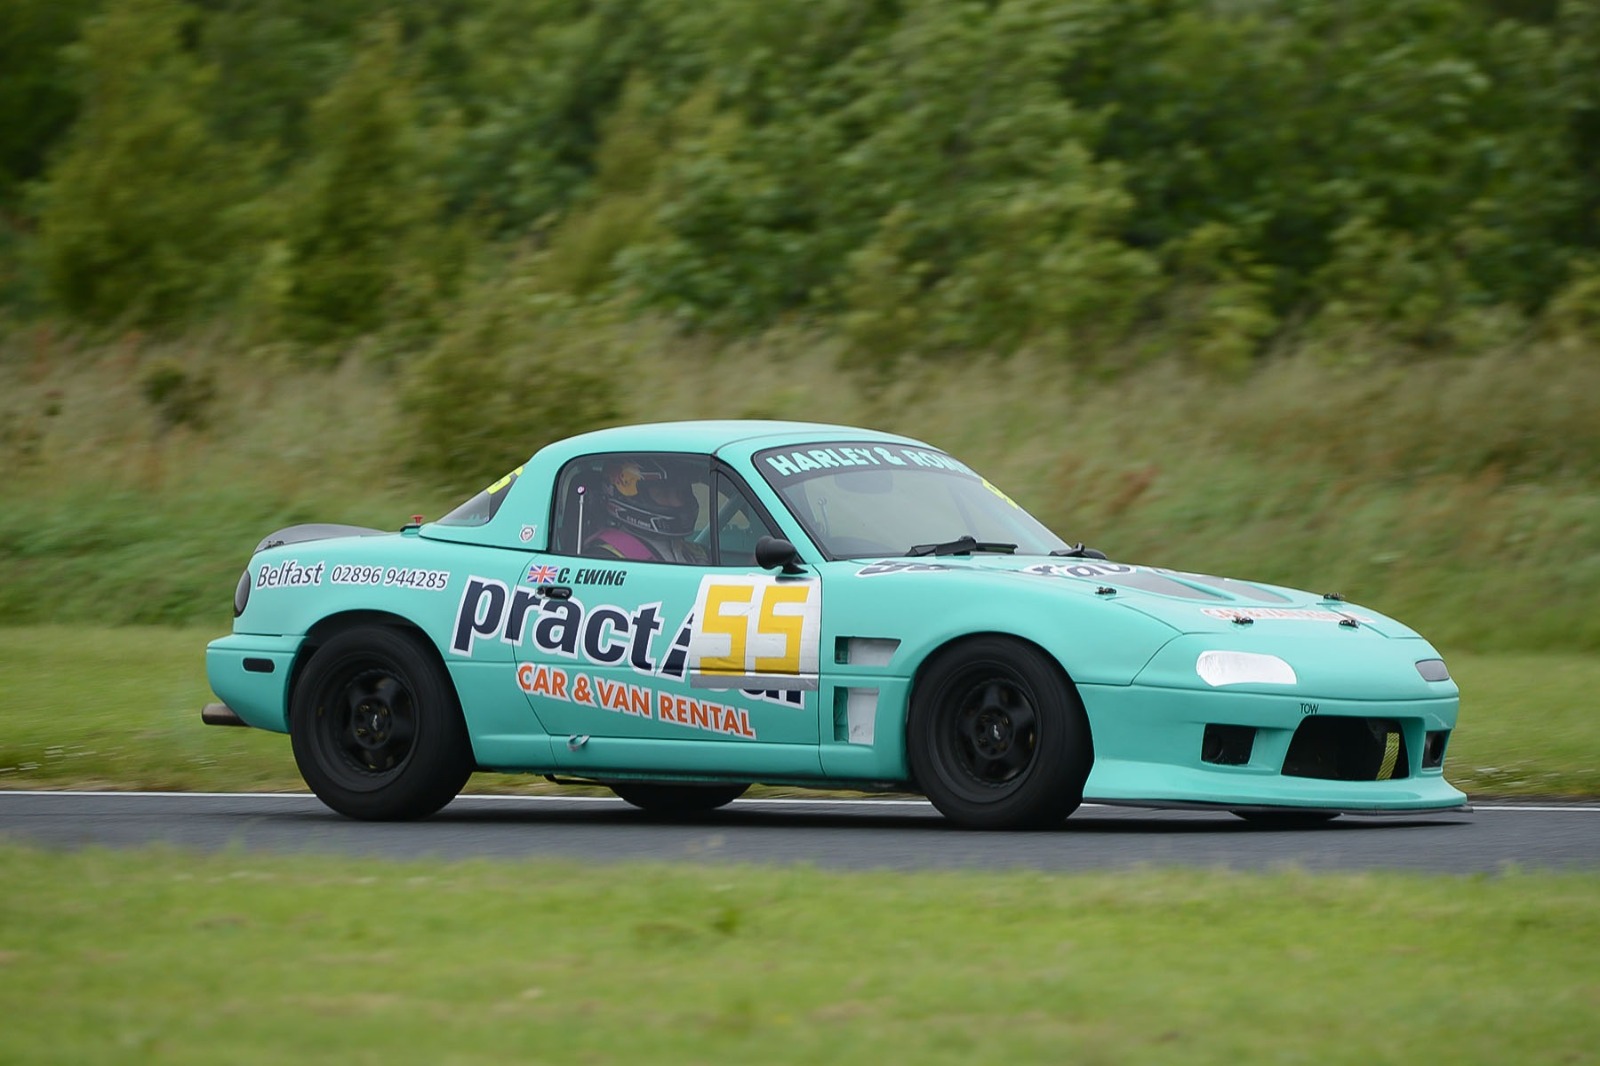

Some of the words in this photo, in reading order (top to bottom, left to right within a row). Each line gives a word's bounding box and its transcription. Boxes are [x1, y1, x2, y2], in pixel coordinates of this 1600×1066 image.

[766, 447, 877, 476] HARLEY
[874, 446, 906, 466] &
[256, 561, 323, 588] Belfast
[331, 565, 382, 584] 02896
[385, 570, 449, 589] 944285
[557, 567, 571, 584] C.
[574, 568, 627, 586] EWING
[700, 585, 810, 676] 55
[517, 665, 567, 698] CAR
[573, 678, 593, 704] &
[596, 681, 652, 717] VAN
[660, 694, 756, 738] RENTAL
[1300, 703, 1319, 715] TOW
